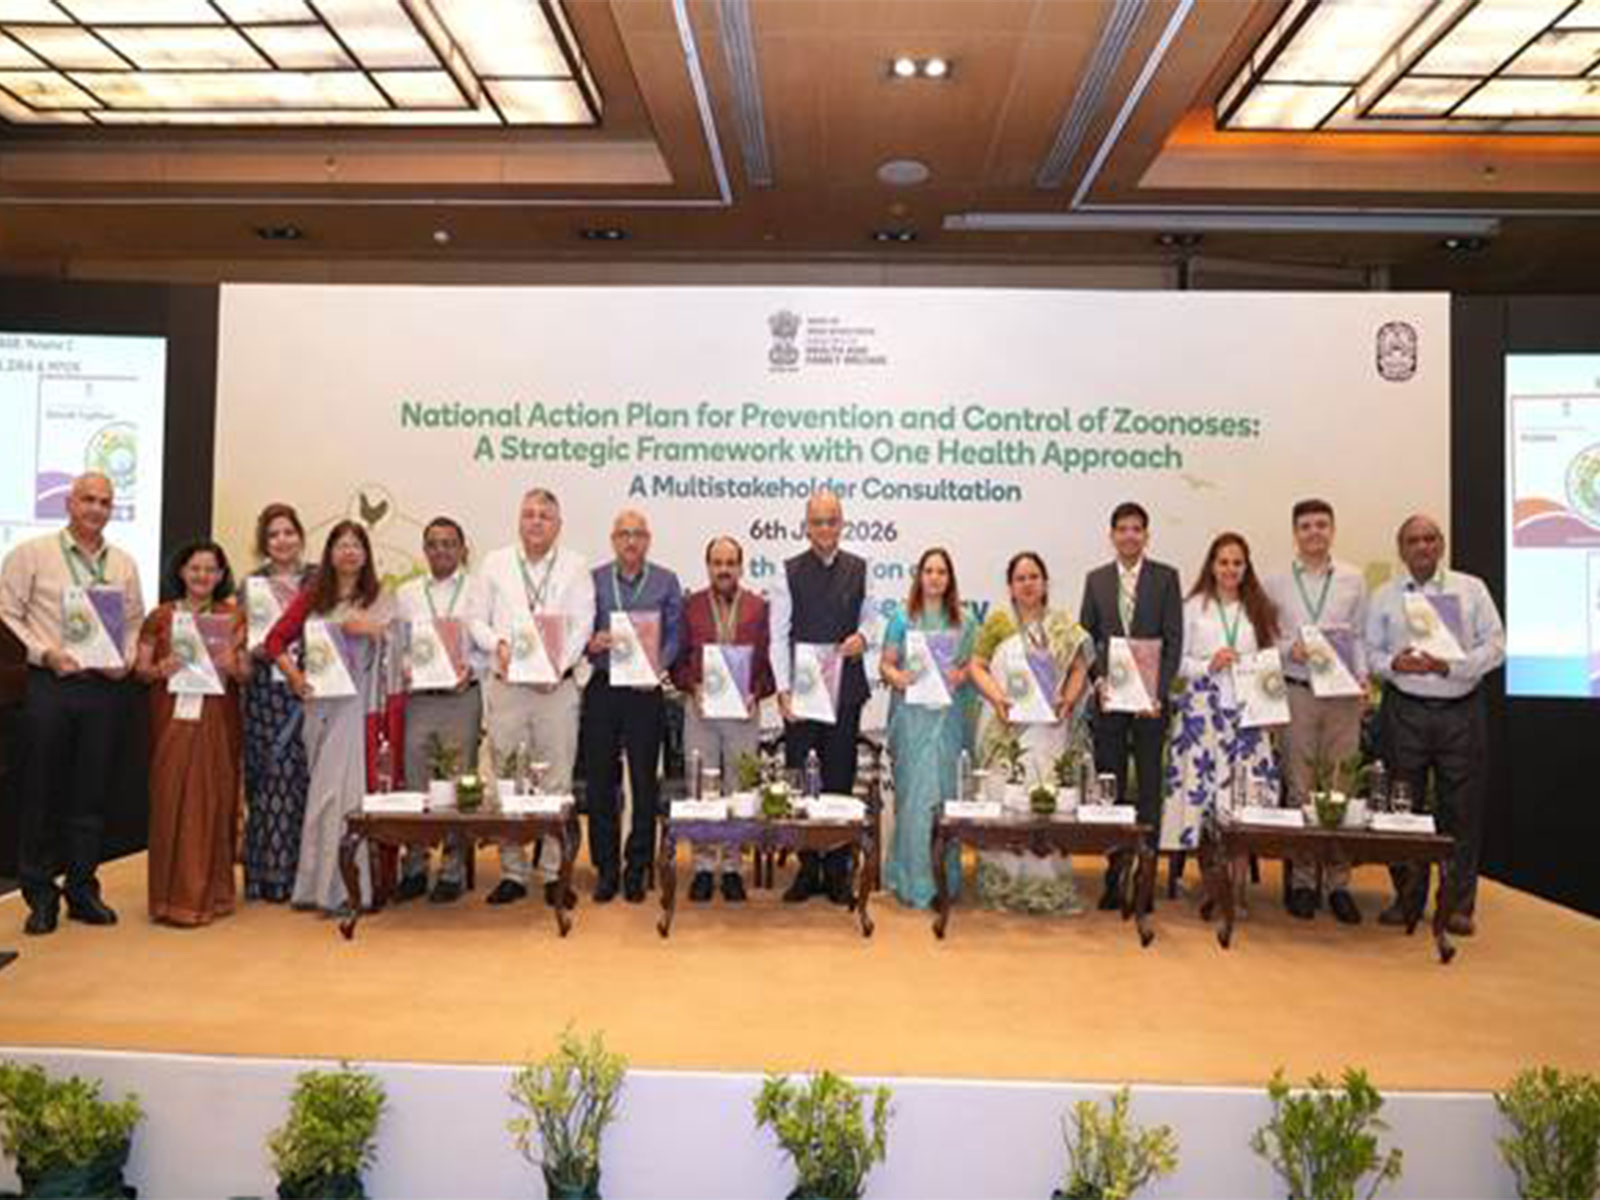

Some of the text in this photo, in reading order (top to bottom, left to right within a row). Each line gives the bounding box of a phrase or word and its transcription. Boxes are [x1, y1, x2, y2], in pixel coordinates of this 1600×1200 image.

[400, 401, 1261, 438] National Action Plan for Prevention and Control of Zoonoses:
[473, 434, 1184, 475] A Strategic Framework with One Health Approach
[627, 474, 1023, 503] A Multistakeholder Consultation
[748, 518, 788, 541] 6th
[843, 520, 899, 543] 2026
